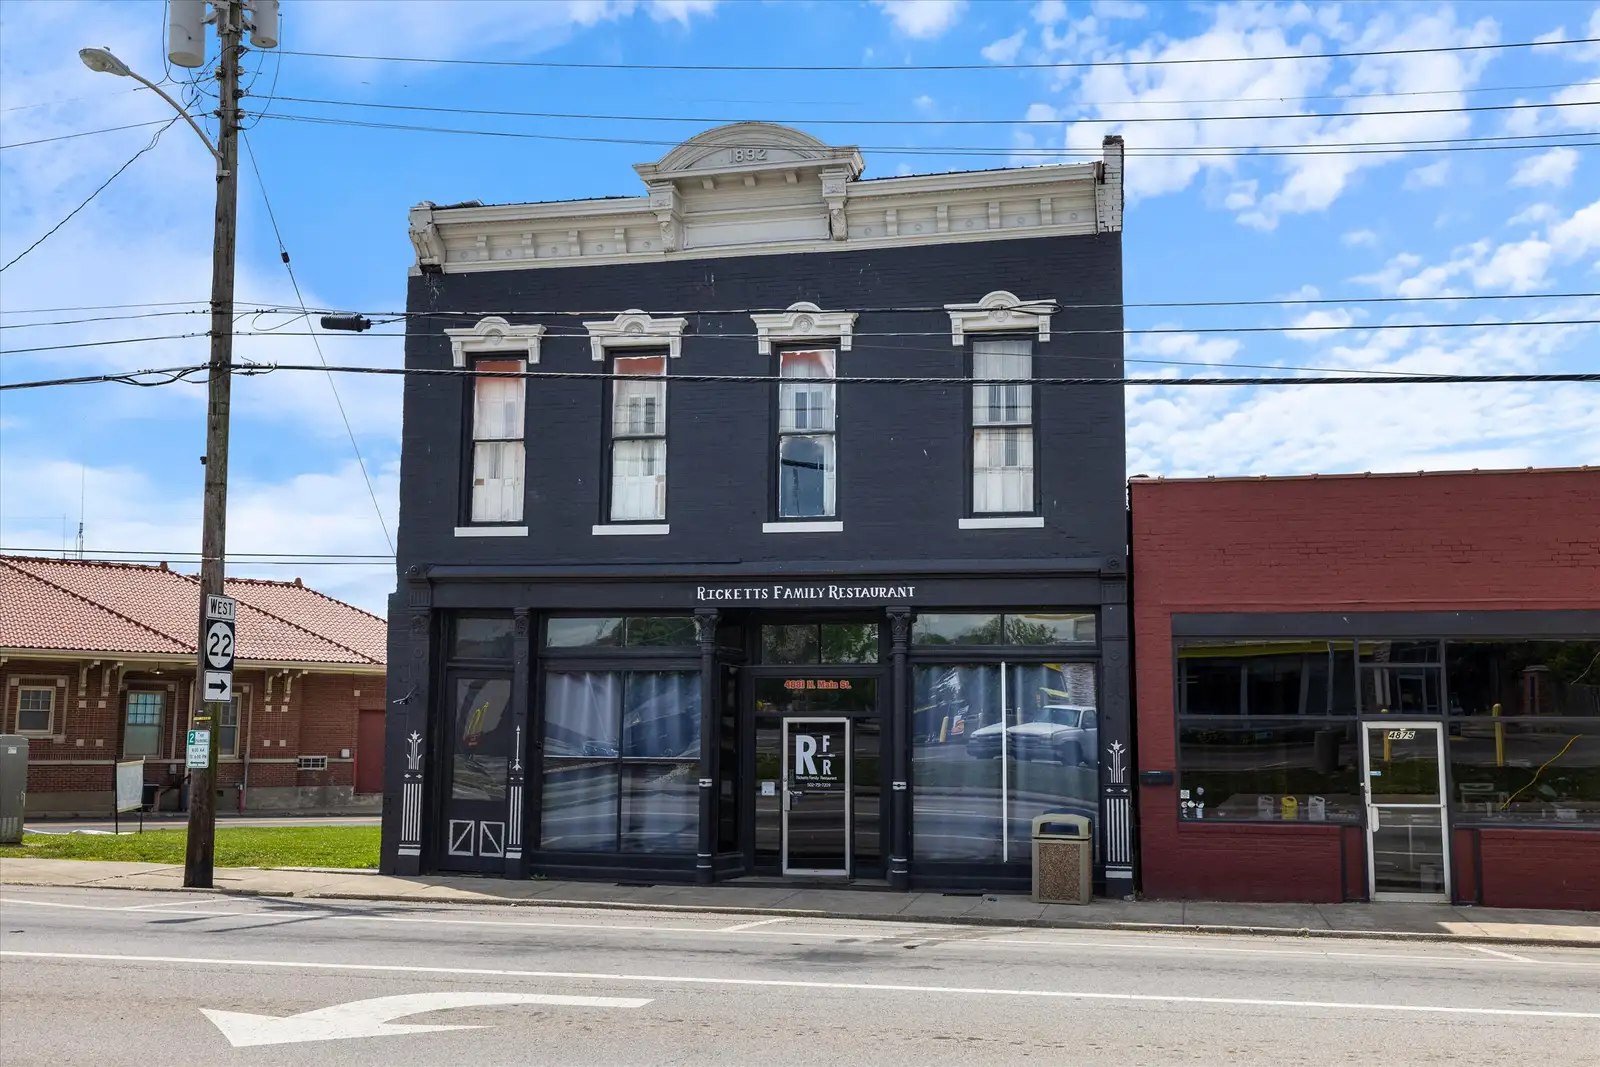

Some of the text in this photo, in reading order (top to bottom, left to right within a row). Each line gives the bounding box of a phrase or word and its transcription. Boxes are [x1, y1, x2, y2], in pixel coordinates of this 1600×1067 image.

[729, 149, 767, 163] 1892
[210, 598, 233, 615] WEST
[209, 632, 231, 657] 22
[817, 680, 838, 689] Main
[839, 680, 852, 689] St.
[189, 733, 195, 743] 2
[1388, 731, 1415, 739] 4875
[796, 735, 830, 775] R F
[823, 760, 831, 775] R
